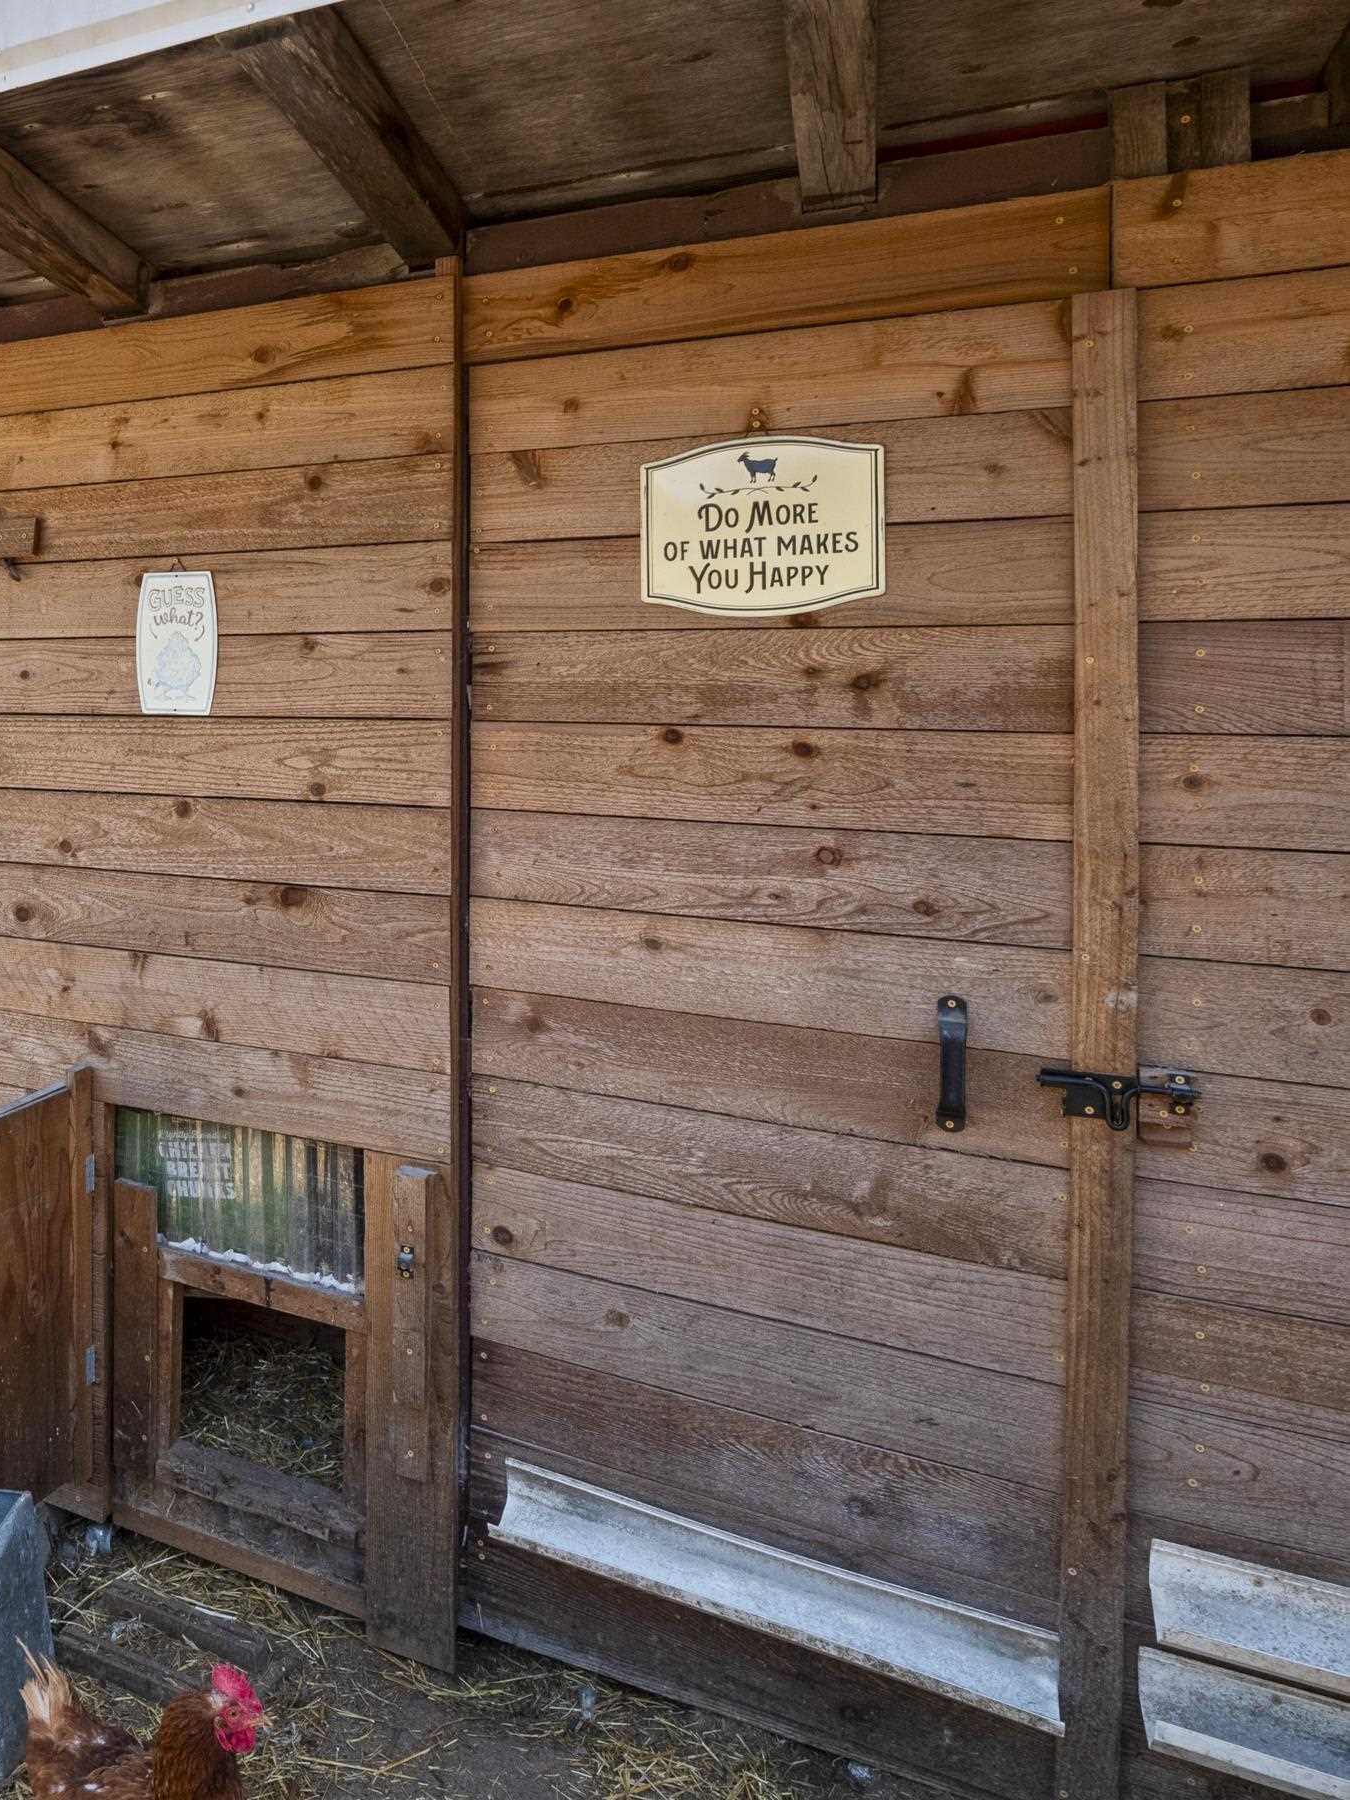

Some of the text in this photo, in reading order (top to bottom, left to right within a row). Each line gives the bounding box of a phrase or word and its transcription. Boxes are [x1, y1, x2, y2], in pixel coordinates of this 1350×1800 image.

[663, 531, 859, 562] OF WHAT MAKES
[745, 561, 830, 594] HAPPY
[149, 586, 205, 611] GUESS
[154, 607, 204, 630] what?
[158, 1141, 232, 1158] CHIC
[167, 1160, 232, 1179] BRET
[167, 1180, 235, 1200] CHUS
